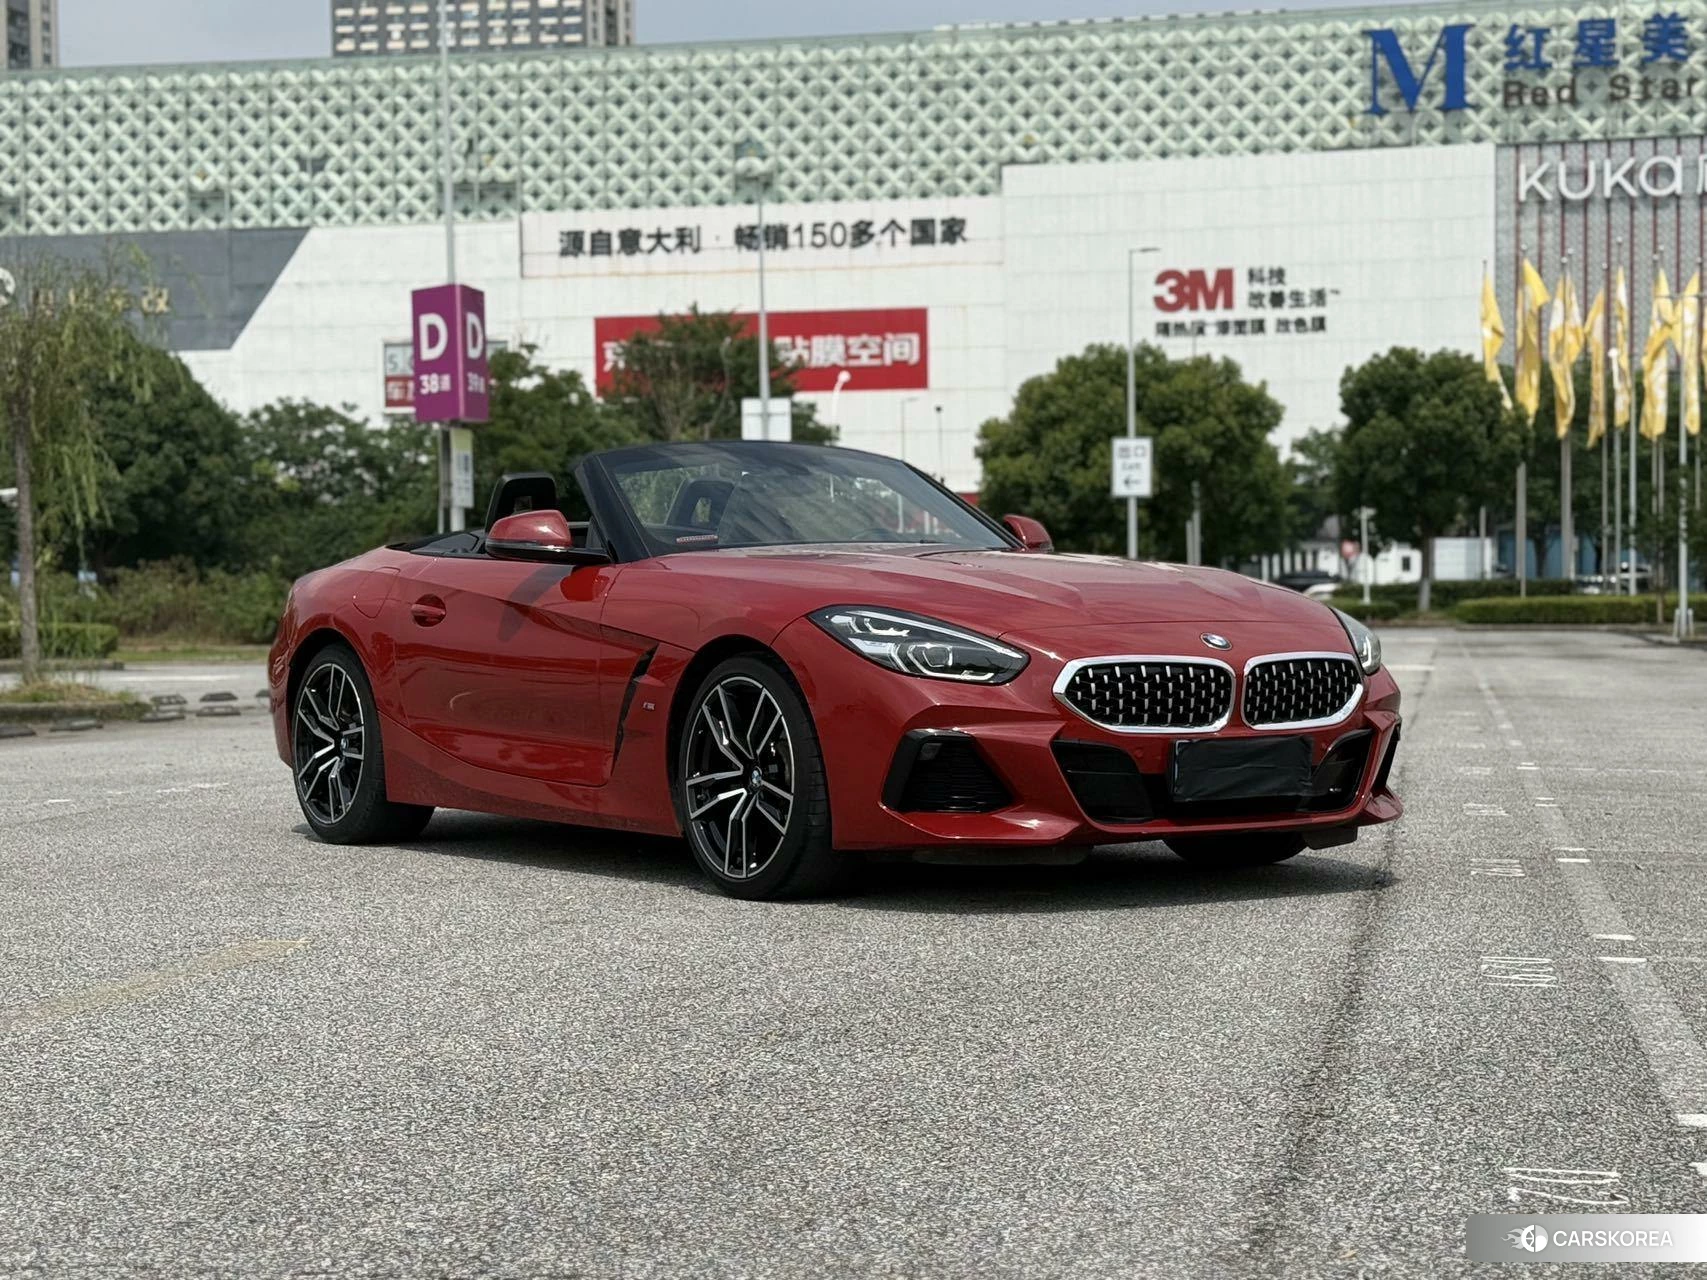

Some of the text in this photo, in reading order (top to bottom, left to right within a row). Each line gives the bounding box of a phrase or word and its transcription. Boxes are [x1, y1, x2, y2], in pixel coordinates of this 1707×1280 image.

[1503, 12, 1690, 70] 红星美
[1362, 24, 1474, 115] M
[1503, 72, 1700, 109] Red Star
[559, 216, 968, 258] 源自意大利 畅销150多个国家
[1153, 267, 1234, 313] 3M
[419, 313, 448, 361] D
[466, 311, 484, 360] D
